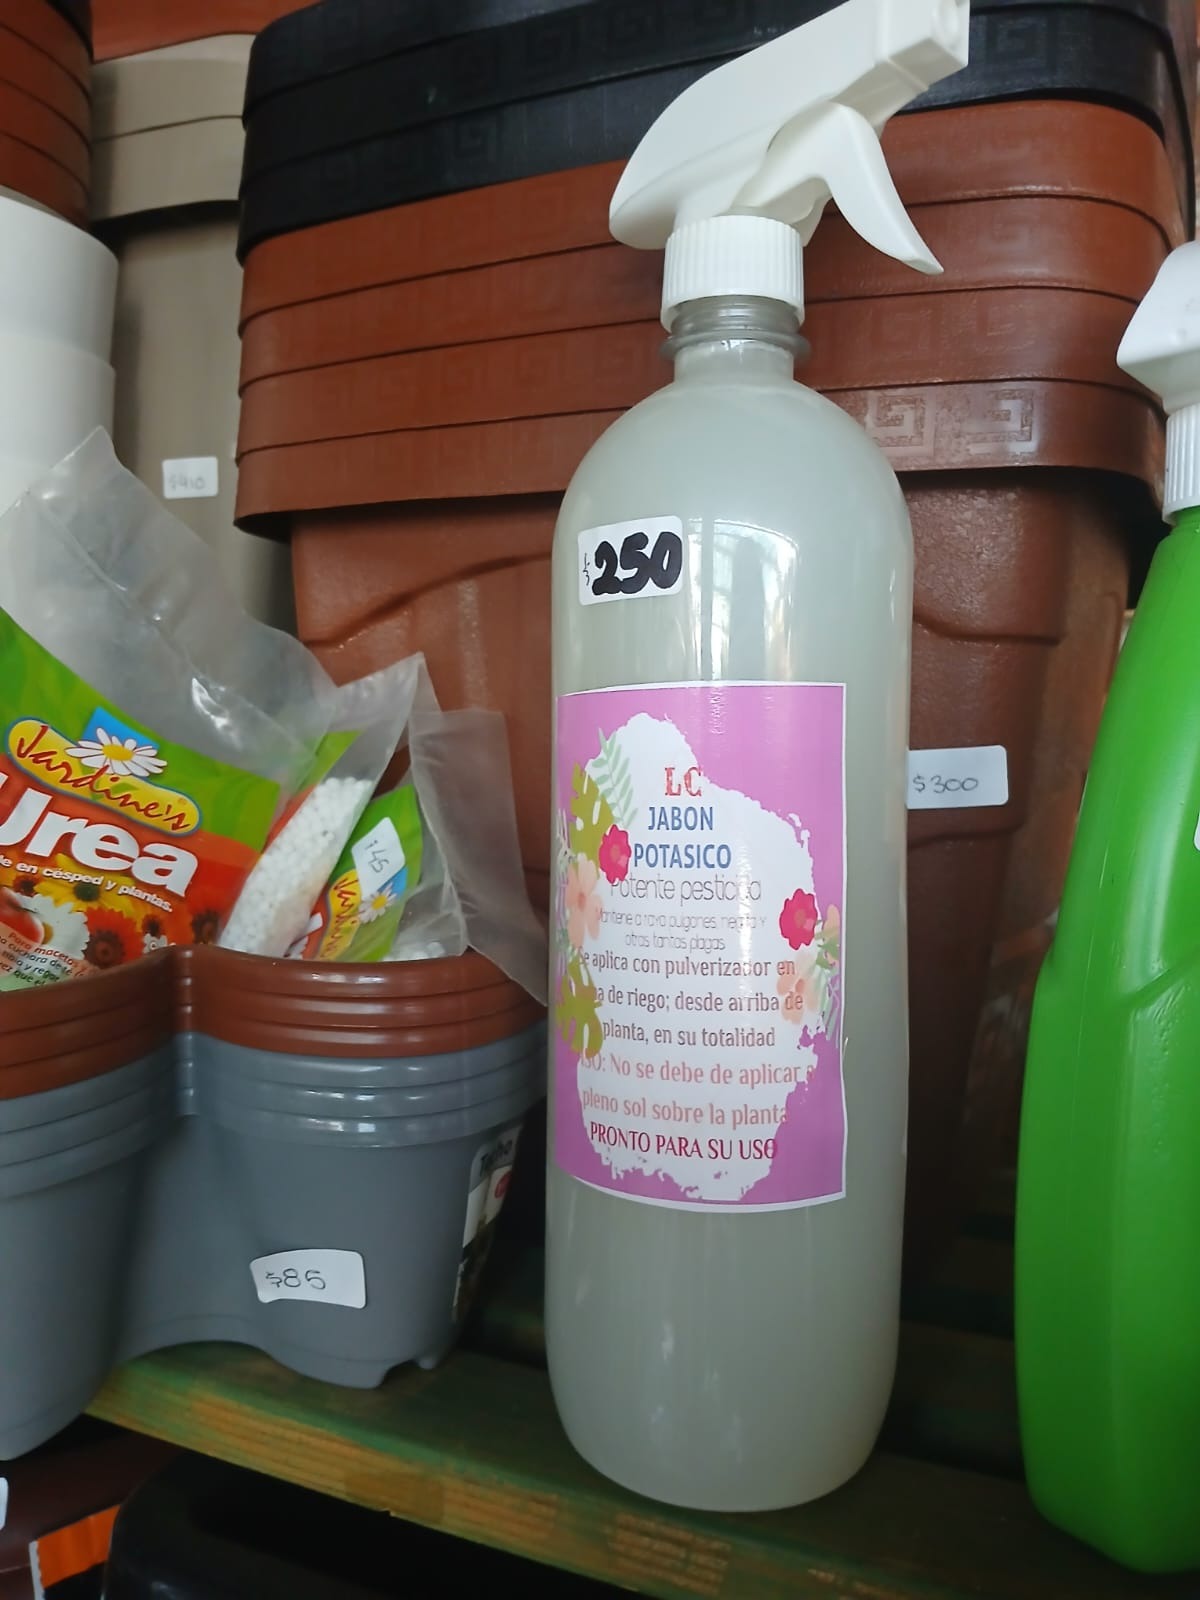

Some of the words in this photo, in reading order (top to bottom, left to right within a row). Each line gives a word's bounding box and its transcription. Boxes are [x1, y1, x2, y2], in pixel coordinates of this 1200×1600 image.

[16, 724, 192, 831] Jardine's
[664, 766, 703, 796] LC
[912, 774, 979, 794] $300
[648, 806, 714, 831] JABON
[633, 843, 732, 869] POTASICO
[16, 860, 38, 875] en
[42, 867, 105, 887] césped
[105, 879, 117, 891] y
[592, 950, 628, 972] aplica
[632, 956, 661, 974] con
[776, 960, 796, 976] en
[608, 985, 624, 1005] de
[627, 990, 671, 1013] riego;
[674, 992, 724, 1012] desde
[729, 994, 780, 1012] arriba
[785, 993, 804, 1011] de
[602, 1020, 650, 1045] planta,
[654, 1028, 673, 1043] en
[678, 1030, 697, 1046] su
[701, 1027, 776, 1047] totalidad
[610, 1054, 631, 1077] No
[636, 1060, 655, 1080] se
[660, 1060, 704, 1083] debe
[710, 1063, 734, 1084] de
[739, 1063, 801, 1090] aplicar
[582, 1087, 619, 1113] pleno
[623, 1096, 648, 1118] sol
[652, 1100, 704, 1124] sobre
[709, 1102, 726, 1124] la
[731, 1103, 788, 1131] planta
[590, 1120, 650, 1152] PRONTO
[656, 1133, 703, 1158] PARA
[708, 1138, 733, 1160] SU
[739, 1138, 778, 1160] USO
